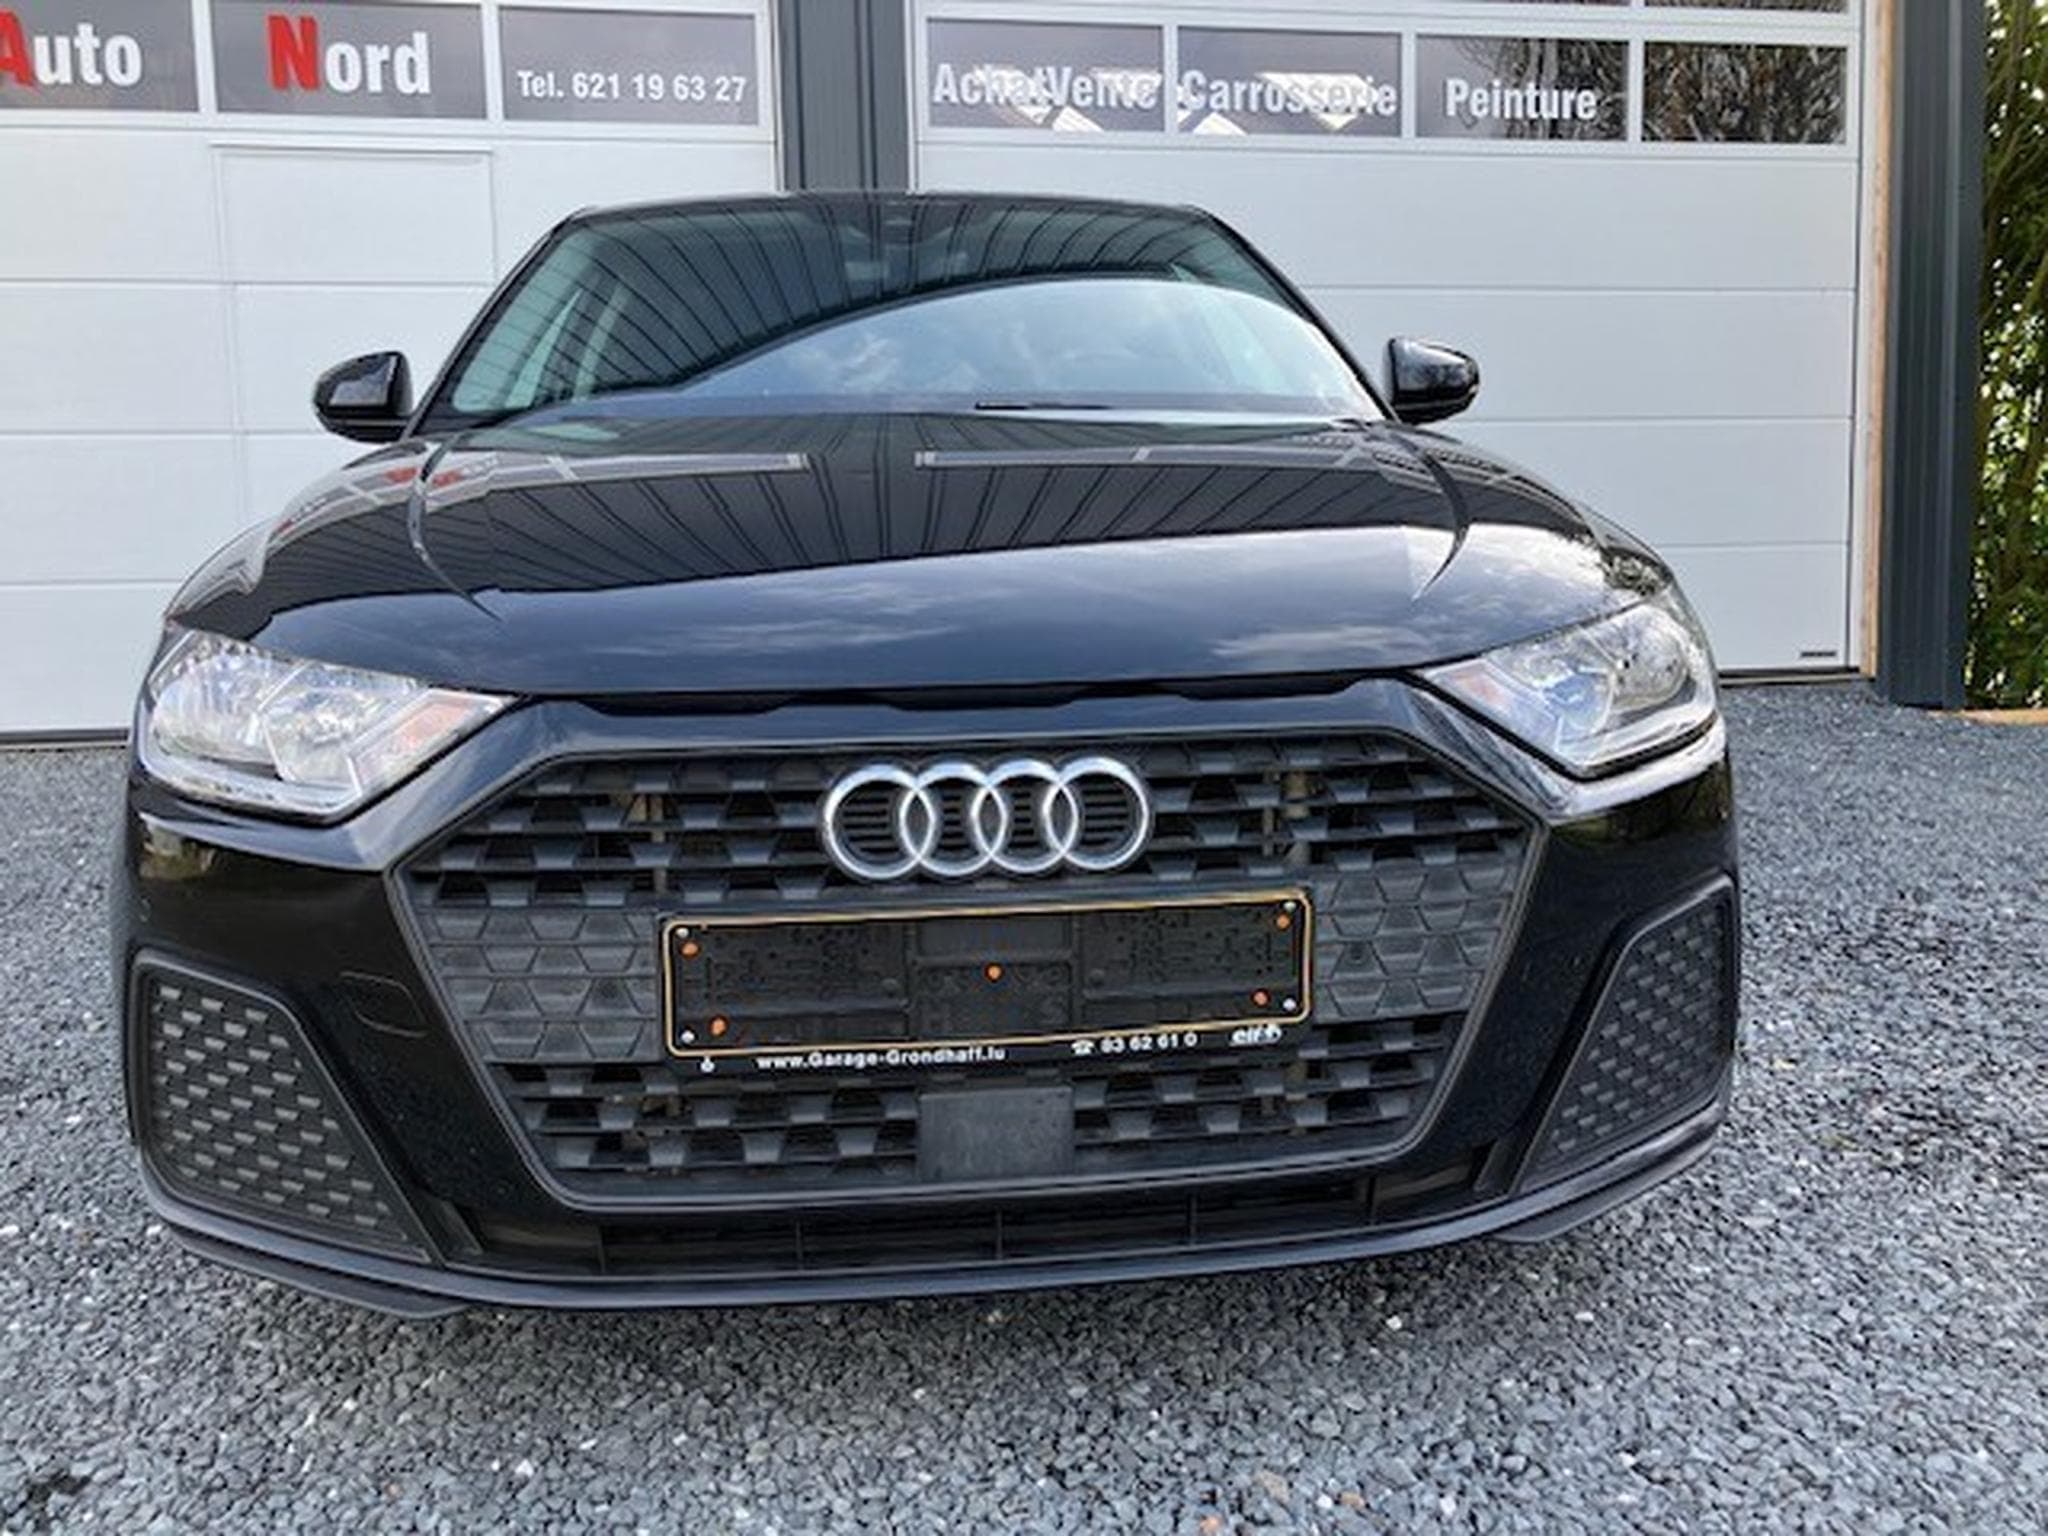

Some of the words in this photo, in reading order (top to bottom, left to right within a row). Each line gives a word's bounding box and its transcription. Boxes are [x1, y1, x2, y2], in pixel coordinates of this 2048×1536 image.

[267, 13, 431, 94] Nord
[517, 70, 565, 98] Tel.
[572, 72, 619, 99] 621
[632, 73, 665, 101] 19
[673, 74, 706, 101] 63
[715, 76, 746, 102] 27
[1181, 69, 1398, 116] Carrosserie
[1446, 78, 1597, 120] Peinture
